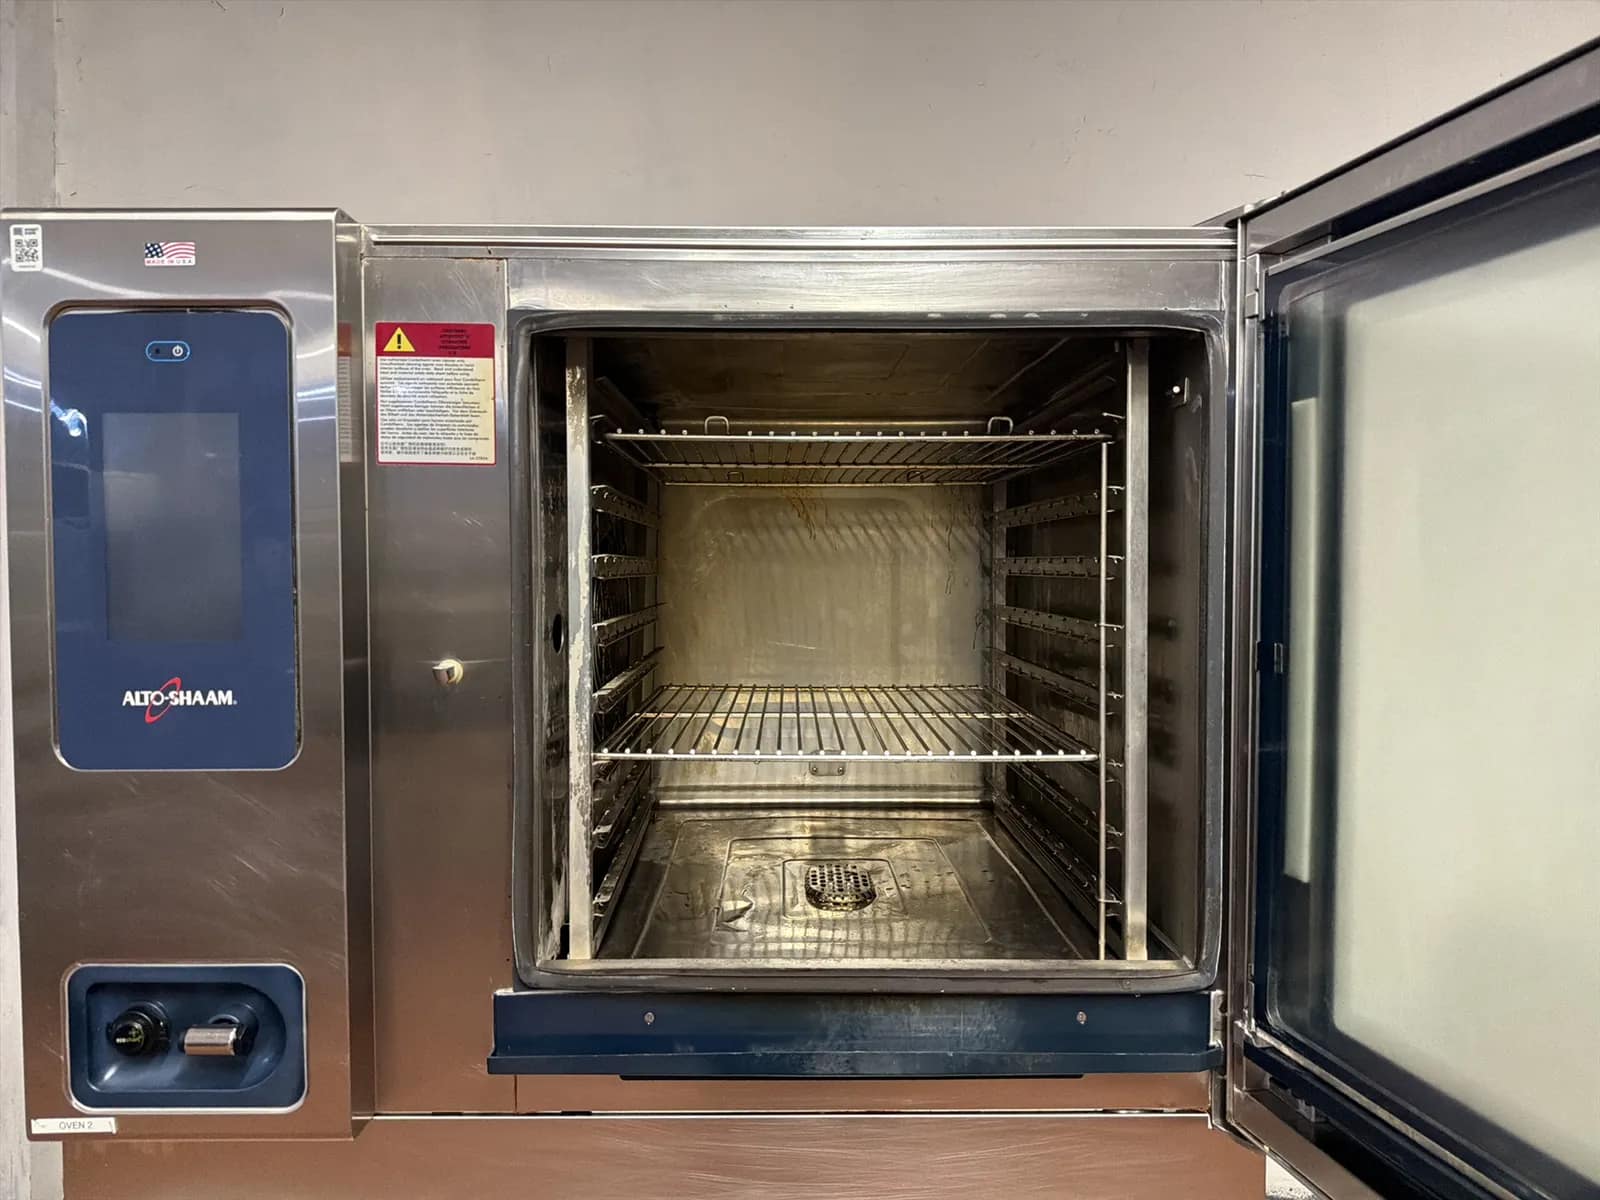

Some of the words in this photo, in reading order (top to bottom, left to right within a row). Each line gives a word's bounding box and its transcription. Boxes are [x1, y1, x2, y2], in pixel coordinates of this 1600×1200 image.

[122, 690, 233, 706] ALTO-SHAAM
[58, 1121, 85, 1130] OVEN
[87, 1120, 94, 1129] 2
